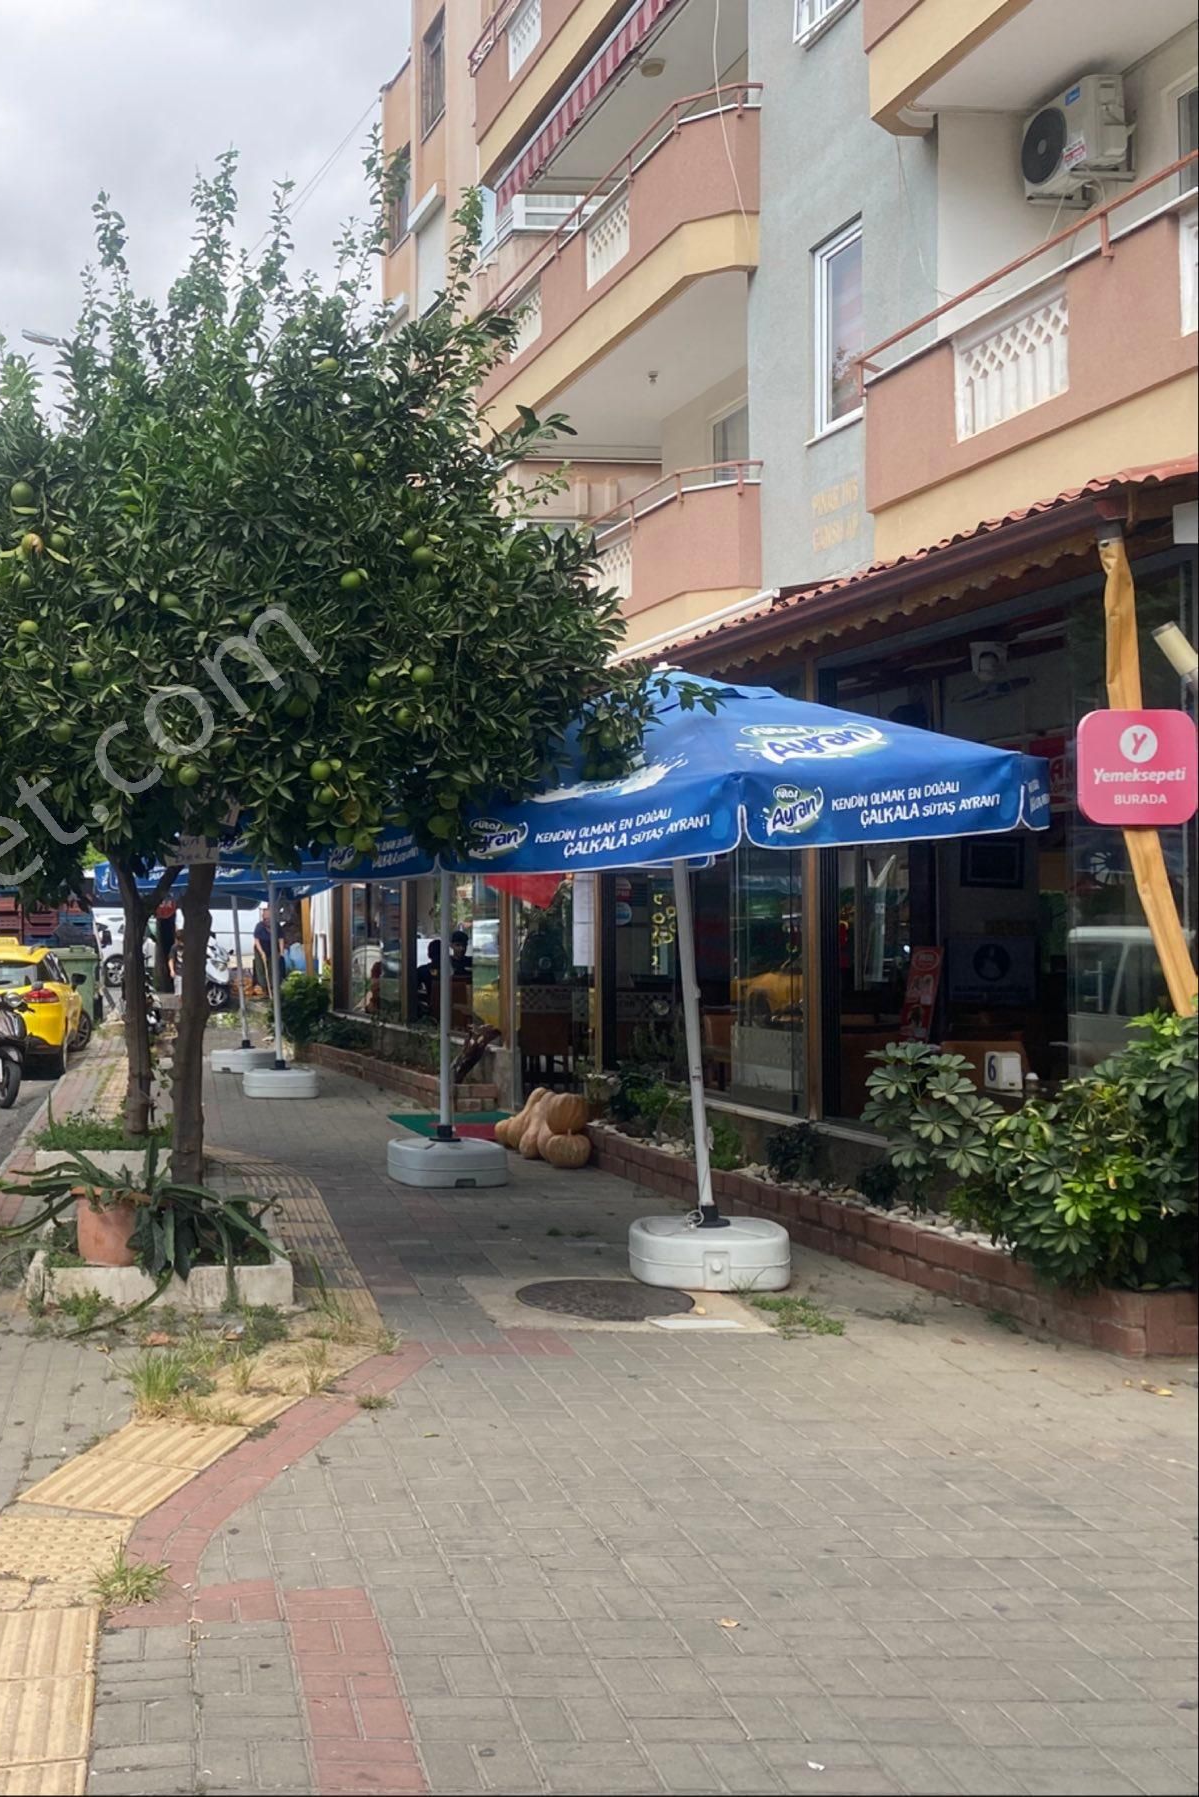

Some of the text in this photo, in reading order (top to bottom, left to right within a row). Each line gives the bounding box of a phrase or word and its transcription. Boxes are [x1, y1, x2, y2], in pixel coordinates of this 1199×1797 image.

[766, 728, 869, 758] Ayran
[1092, 767, 1187, 785] Yemeksepeti
[831, 781, 960, 811] KENDİN OLMAK EN DOĞALI
[1113, 793, 1168, 805] BURADA
[534, 808, 672, 844] KENDİN OLMAK EN DOĞALI
[772, 796, 816, 829] Ayran
[860, 803, 920, 828] ÇALKALA
[922, 801, 956, 818] SÜTAŞ
[563, 813, 710, 858] ÇALKALA SÜTAŞ AYRAN'I
[987, 1055, 997, 1082] 6
